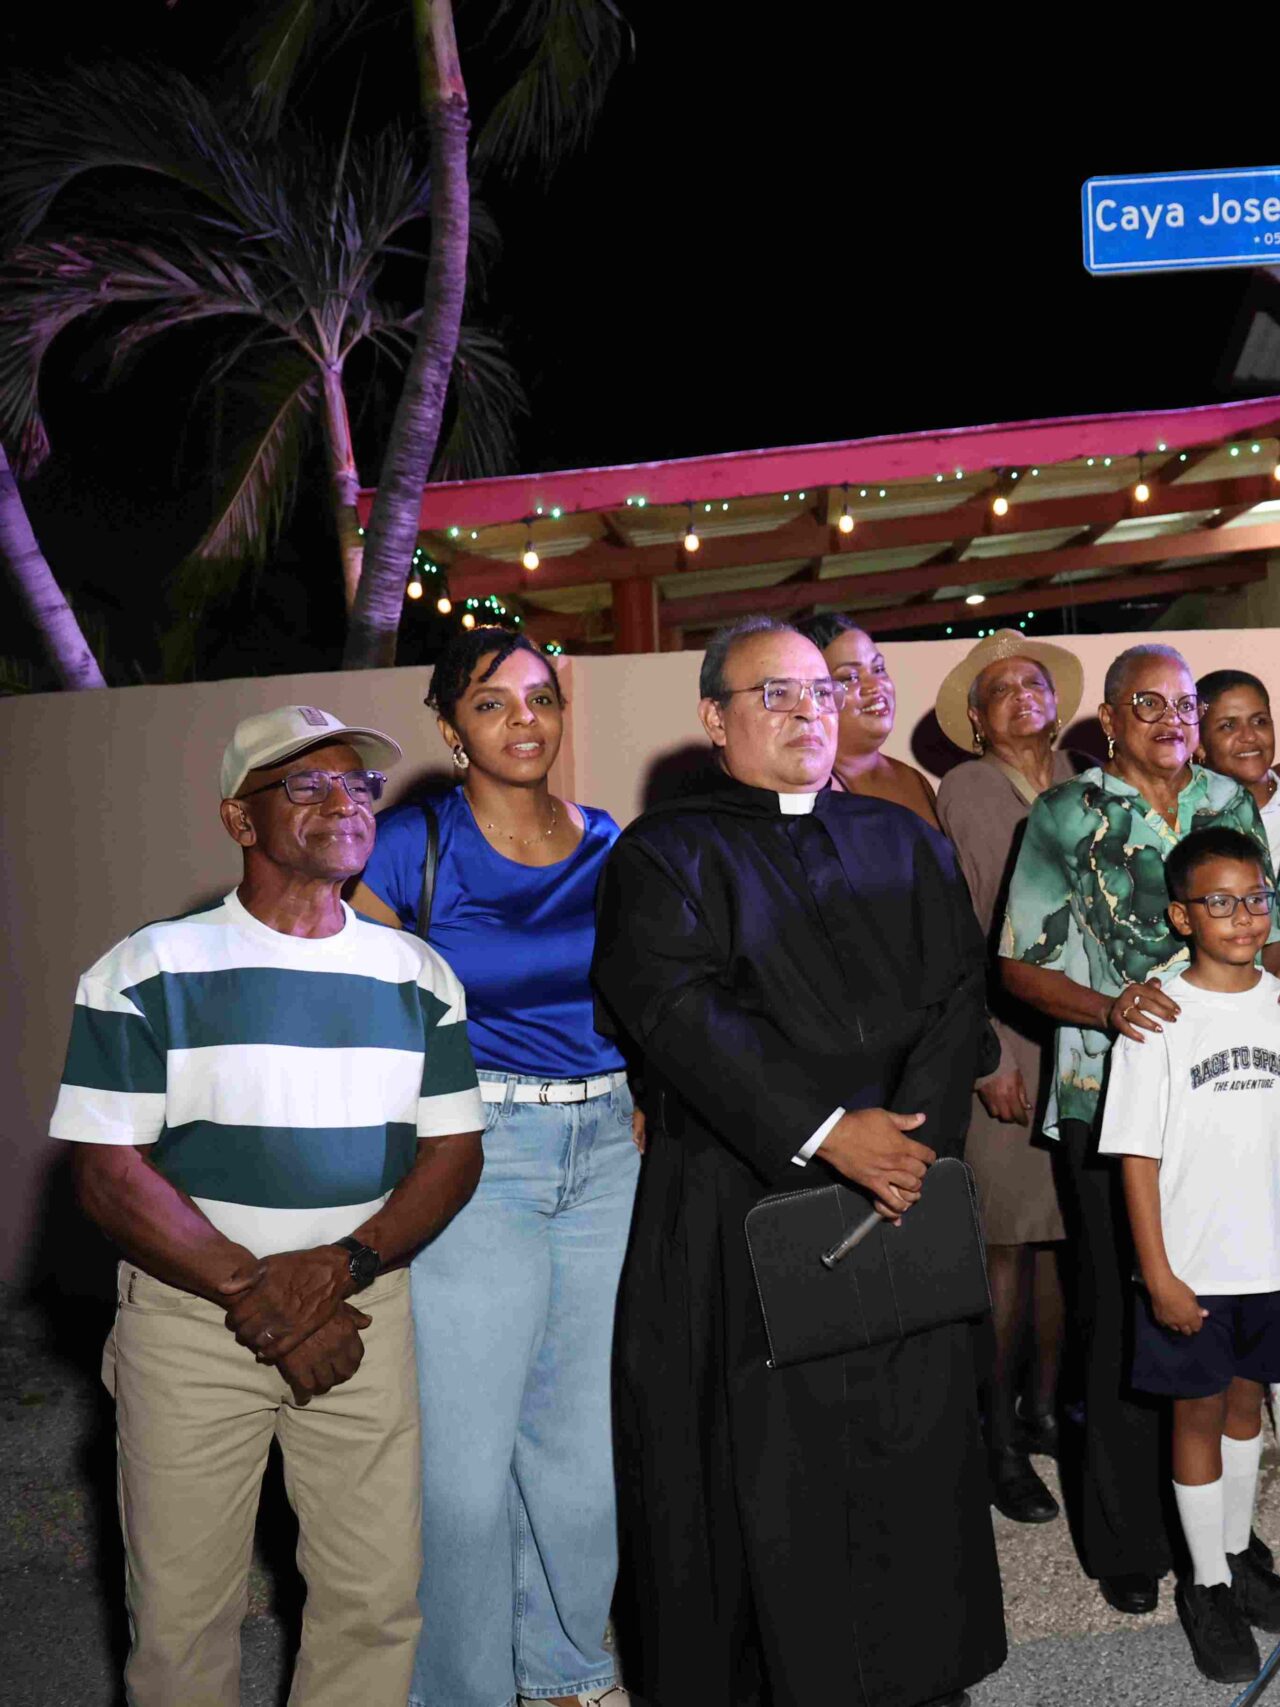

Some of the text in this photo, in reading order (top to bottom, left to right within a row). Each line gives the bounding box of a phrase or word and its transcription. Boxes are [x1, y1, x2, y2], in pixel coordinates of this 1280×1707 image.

[1095, 199, 1185, 239] Caya
[1190, 1049, 1230, 1090] RACE
[1231, 1045, 1251, 1070] TO
[1213, 1078, 1276, 1093] THE ADVENTURE
